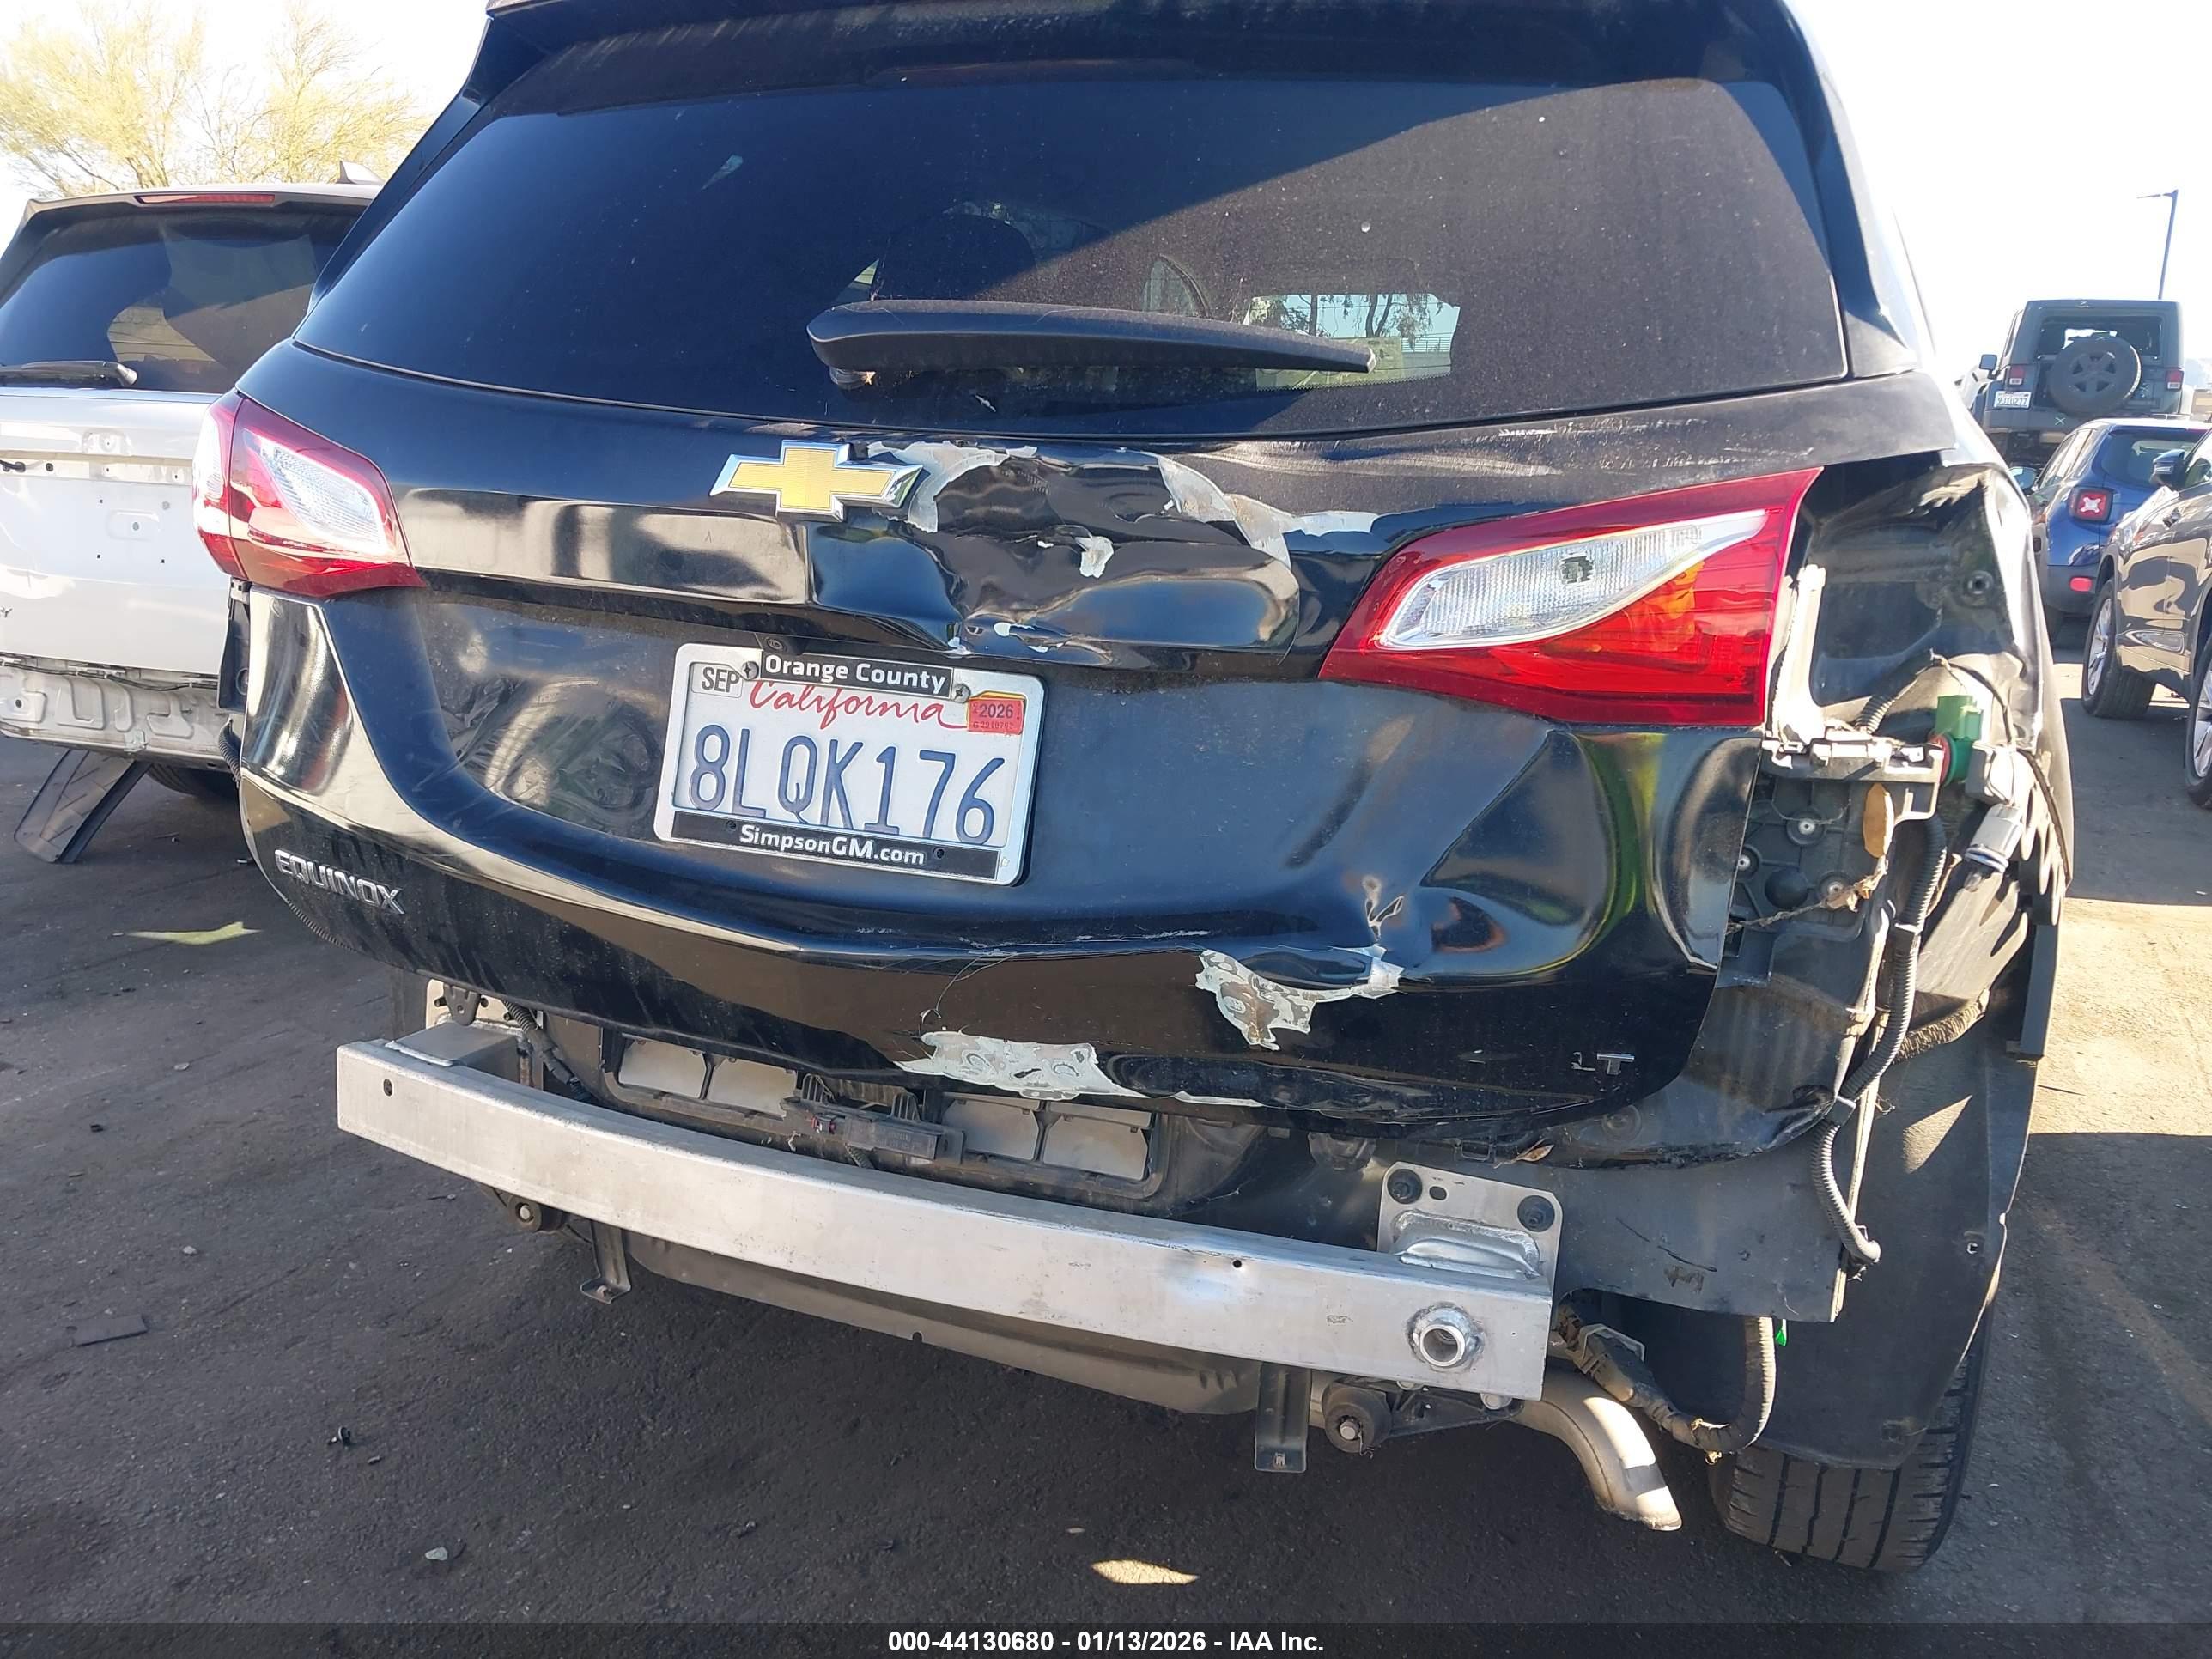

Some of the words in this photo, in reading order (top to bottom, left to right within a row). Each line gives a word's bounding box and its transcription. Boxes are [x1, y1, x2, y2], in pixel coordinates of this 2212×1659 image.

[701, 666, 741, 693] SEP
[764, 654, 849, 684] Orange
[855, 663, 946, 694] County
[749, 679, 968, 730] California
[979, 703, 1014, 719] 2026
[689, 724, 1006, 845] 8LQK176
[739, 823, 926, 866] SimpsonGM.com
[274, 849, 405, 915] EQUINOX
